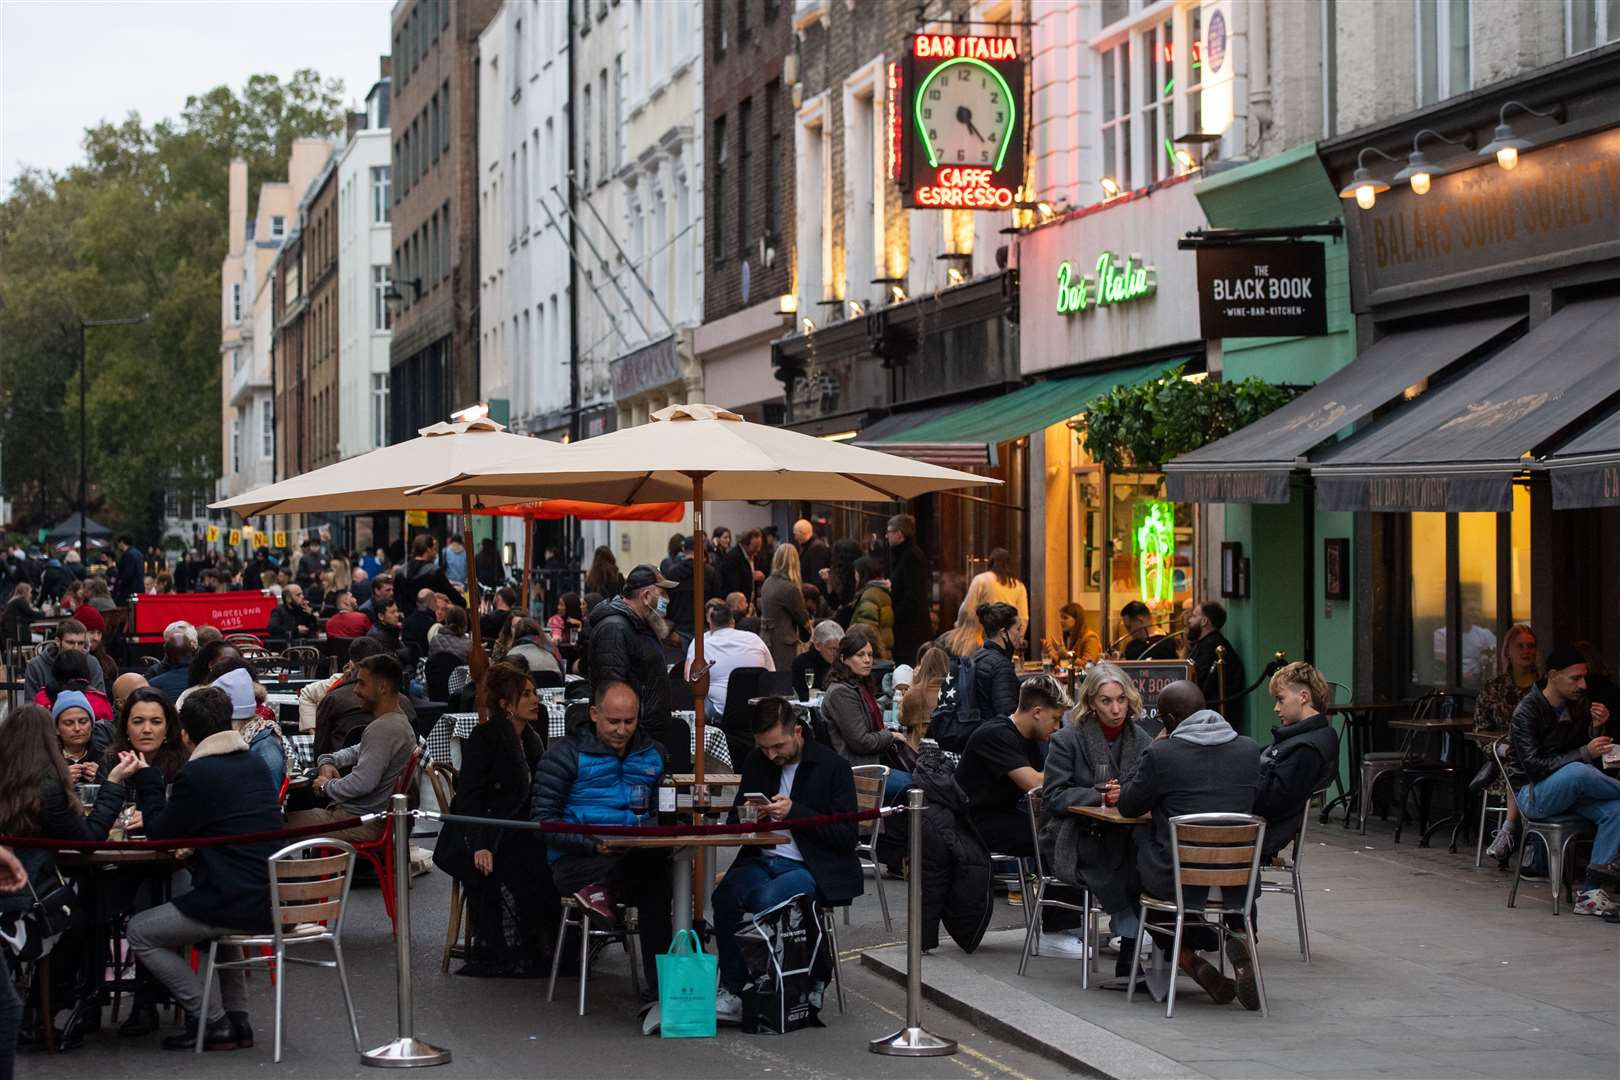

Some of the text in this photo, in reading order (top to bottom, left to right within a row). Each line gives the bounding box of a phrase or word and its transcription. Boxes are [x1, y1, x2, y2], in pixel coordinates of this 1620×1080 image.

[916, 36, 1016, 59] BAR ITALIA
[958, 70, 970, 82] 12
[940, 77, 948, 87] 11
[929, 90, 941, 101] 10
[990, 93, 998, 104] 2
[923, 108, 932, 119] 9
[995, 111, 1003, 123] 3
[929, 129, 937, 140] 8
[988, 132, 996, 142] 4
[957, 150, 965, 161] 6
[981, 151, 989, 162] 5
[940, 168, 992, 188] CAFFE
[1373, 202, 1452, 268] BALANS
[1460, 186, 1516, 249] SOHO
[1254, 265, 1269, 276] THE
[1056, 251, 1148, 315] Bar Italia
[1213, 277, 1312, 301] BLACK BOOK
